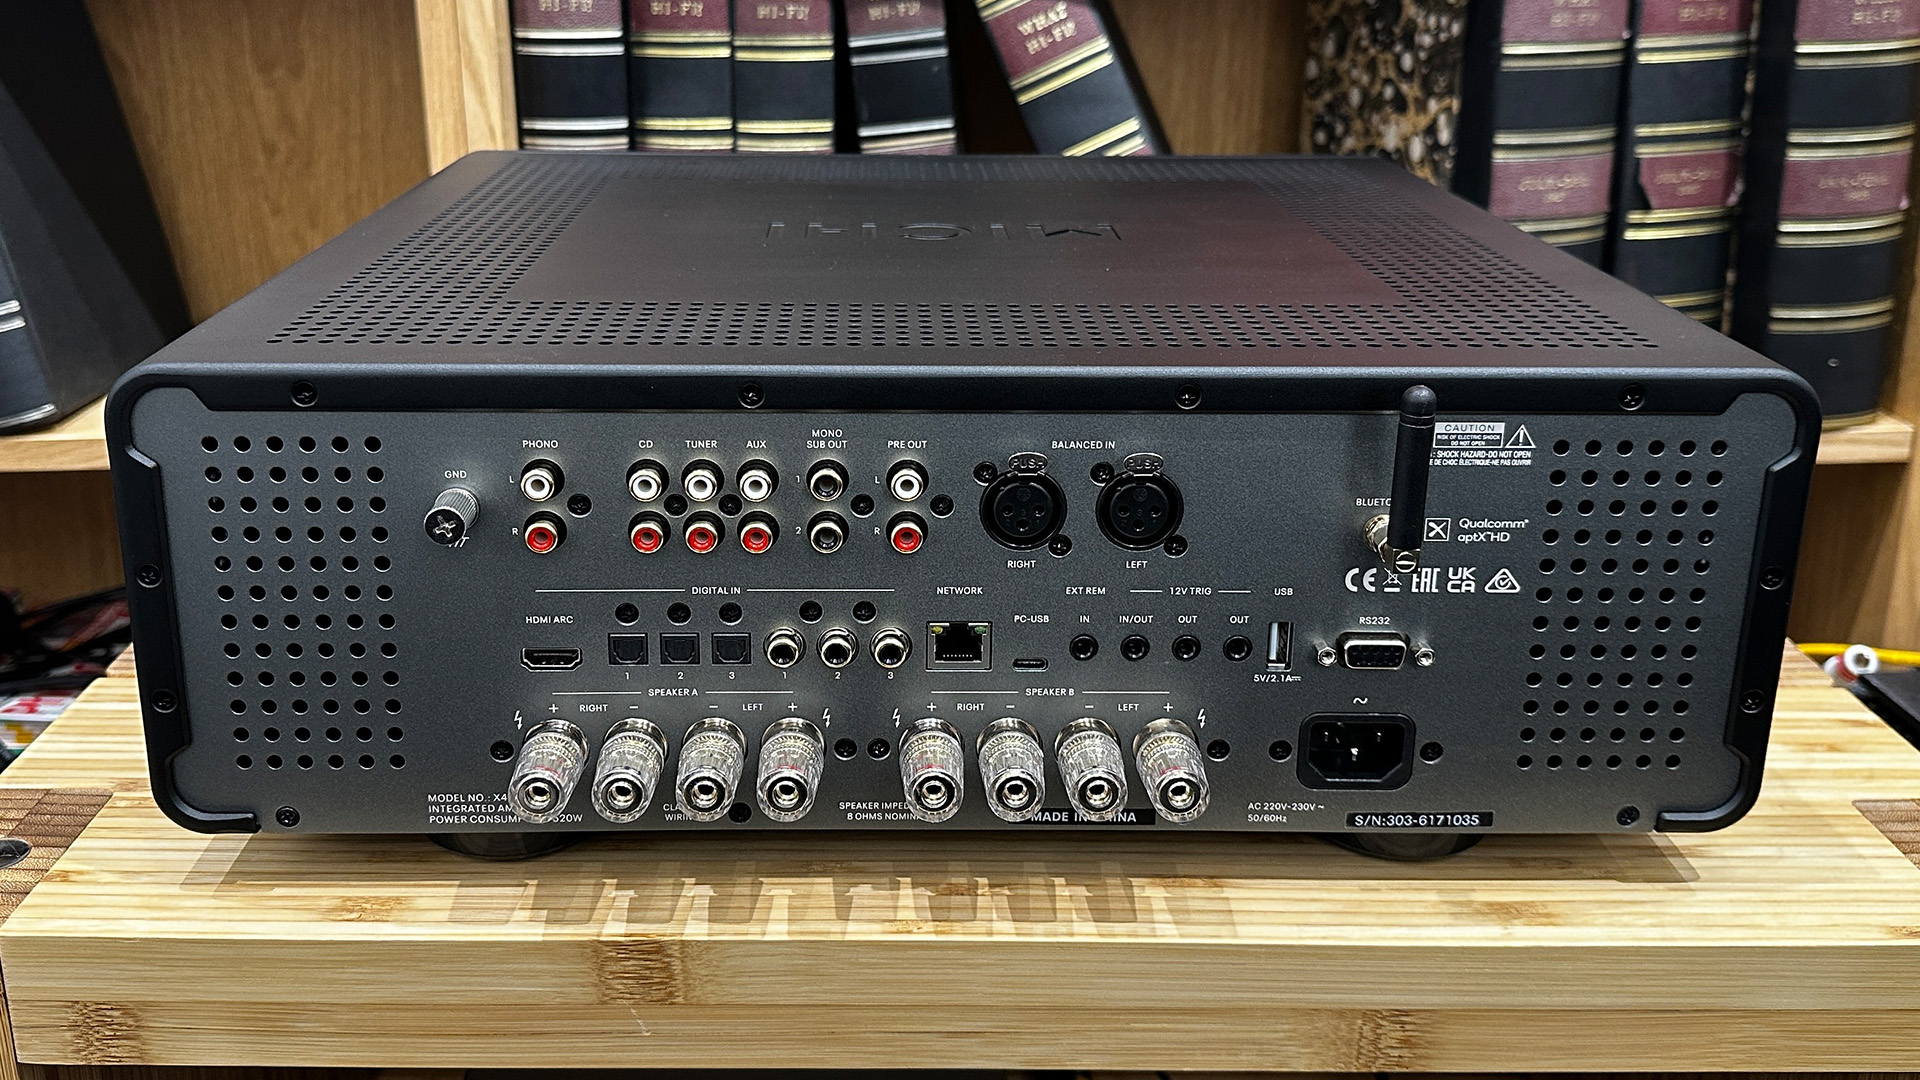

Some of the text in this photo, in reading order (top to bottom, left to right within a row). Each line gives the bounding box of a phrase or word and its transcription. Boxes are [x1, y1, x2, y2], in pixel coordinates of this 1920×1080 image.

[1444, 423, 1496, 432] CAUTION
[811, 428, 843, 439] MONO
[522, 439, 559, 449] PHONO
[638, 439, 654, 449] CD
[684, 439, 718, 449] TUNER
[746, 440, 767, 449] AUX
[806, 440, 848, 449] SUB OUT
[887, 440, 928, 449] PRE OUT
[1051, 440, 1116, 450] BALANCED IN
[1436, 450, 1532, 458] SHOCK HAZARD-DO NOT OPEN
[1010, 458, 1045, 469] PUSH
[444, 470, 468, 480] GND
[1355, 497, 1392, 507] BLUETO
[511, 527, 519, 536] R
[1007, 559, 1037, 569] RIGHT
[1125, 560, 1148, 569] LEFT
[1448, 566, 1476, 580] UK
[1344, 568, 1378, 592] CE
[691, 586, 741, 595] DIGITAL IN
[936, 586, 984, 595] NETWORK
[1065, 586, 1106, 595] EXT REM
[1169, 586, 1212, 596] 12V TRIG
[1446, 580, 1476, 593] CA
[1274, 587, 1294, 596] USB
[525, 615, 574, 624] HDMI ARC
[1013, 614, 1050, 623] PC-USB
[1079, 615, 1090, 623] IN
[1119, 615, 1154, 624] IN/OUT
[1177, 615, 1198, 624] OUT
[1229, 615, 1250, 624] OUT
[1359, 616, 1391, 625] RS232
[677, 671, 684, 680] 2
[728, 671, 736, 680] 3
[834, 671, 841, 680] 2
[887, 671, 894, 680] 3
[647, 688, 699, 697] SPEAKER A
[1025, 688, 1075, 697] SPEAKER B
[579, 703, 609, 713] RIGHT
[742, 703, 764, 712] LEFT
[956, 702, 985, 712] RIGHT
[1117, 703, 1140, 712] LEFT
[428, 794, 466, 802] MODEL
[428, 804, 496, 814] INTEGRATED
[839, 801, 910, 810] SPEAKER IMPED
[1247, 802, 1316, 812] AC 220V-230V
[430, 816, 468, 824] POWER
[846, 812, 854, 820] 8
[854, 812, 882, 820] OHMS
[1031, 811, 1069, 822] MADE
[1074, 811, 1089, 822] IN
[1247, 814, 1287, 823] 50/60Hz
[1354, 814, 1480, 826] S/N:303-6171035
